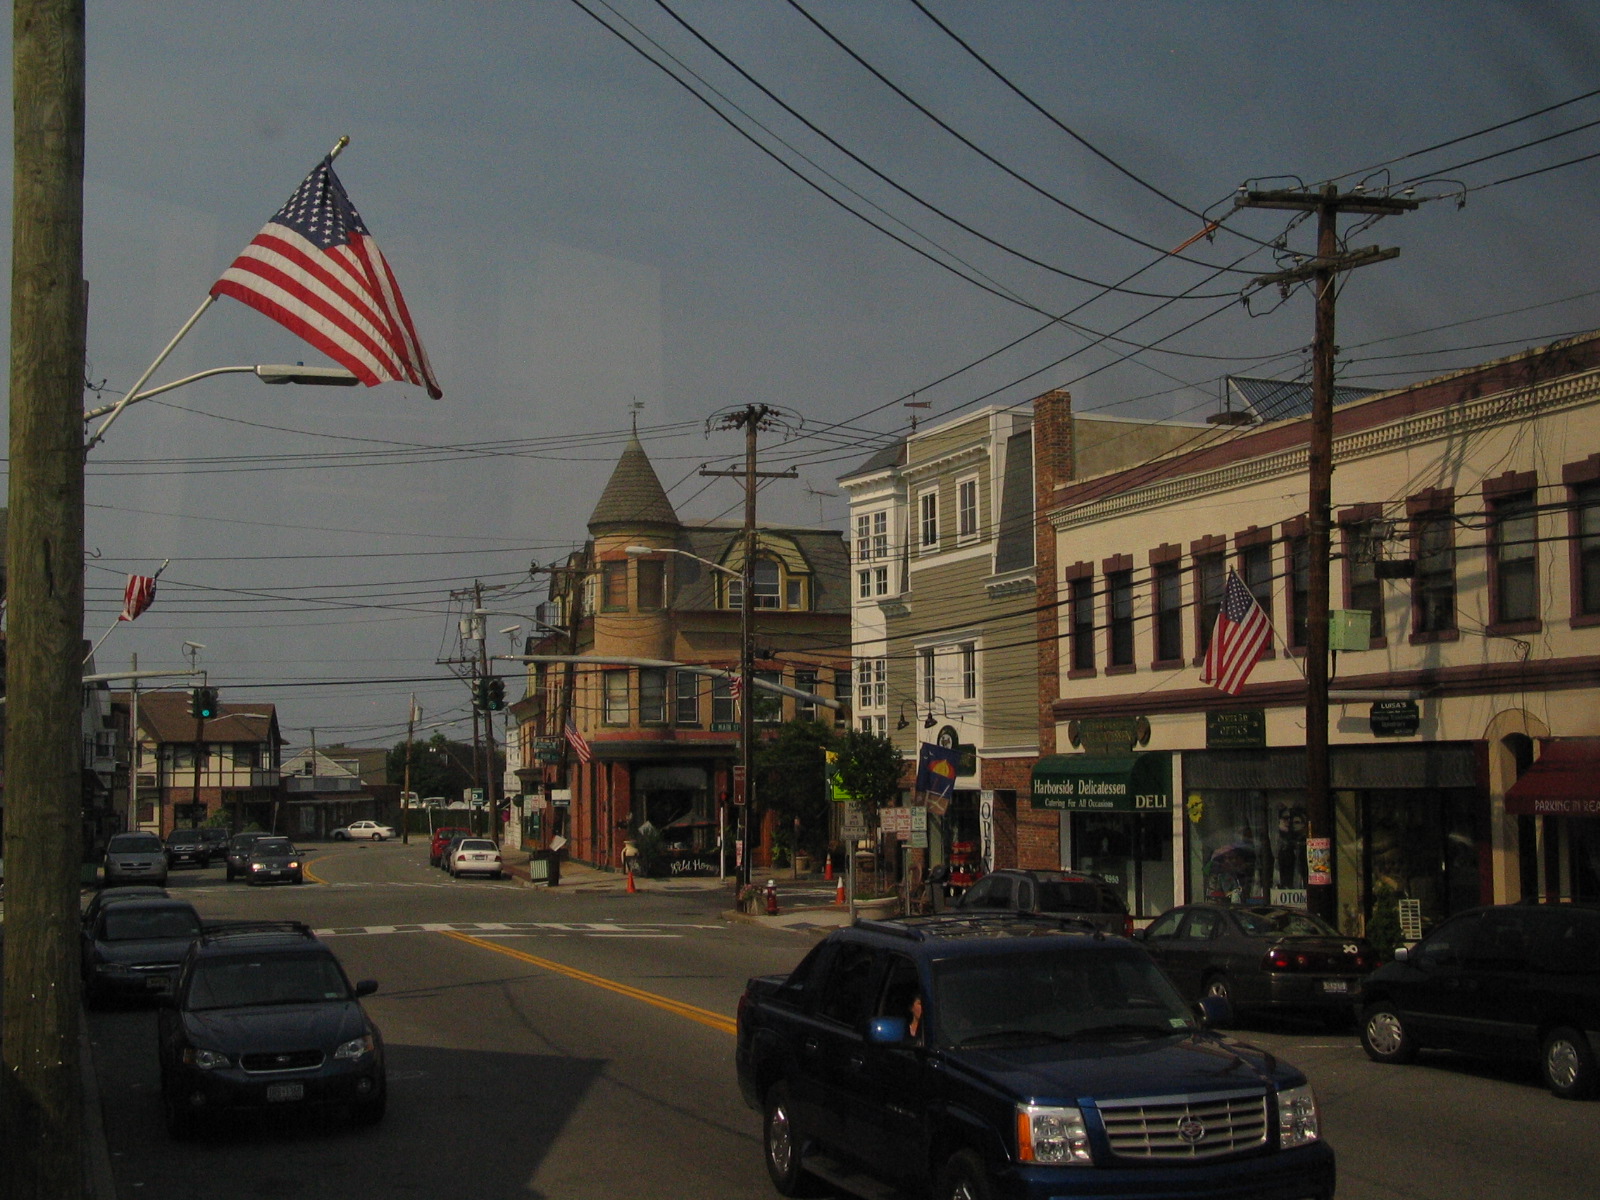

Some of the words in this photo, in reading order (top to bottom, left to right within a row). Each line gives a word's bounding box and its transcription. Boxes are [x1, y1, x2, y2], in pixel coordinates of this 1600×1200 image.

[1034, 779, 1073, 795] Harborside
[1078, 779, 1126, 795] Delicatessen
[1044, 798, 1065, 809] Catering
[1067, 799, 1076, 808] For
[1079, 799, 1087, 808] All
[1088, 799, 1114, 808] Occasions
[1135, 795, 1167, 808] DELI
[1534, 800, 1570, 811] PARKING
[982, 801, 992, 875] OPEN
[670, 859, 692, 874] Wild
